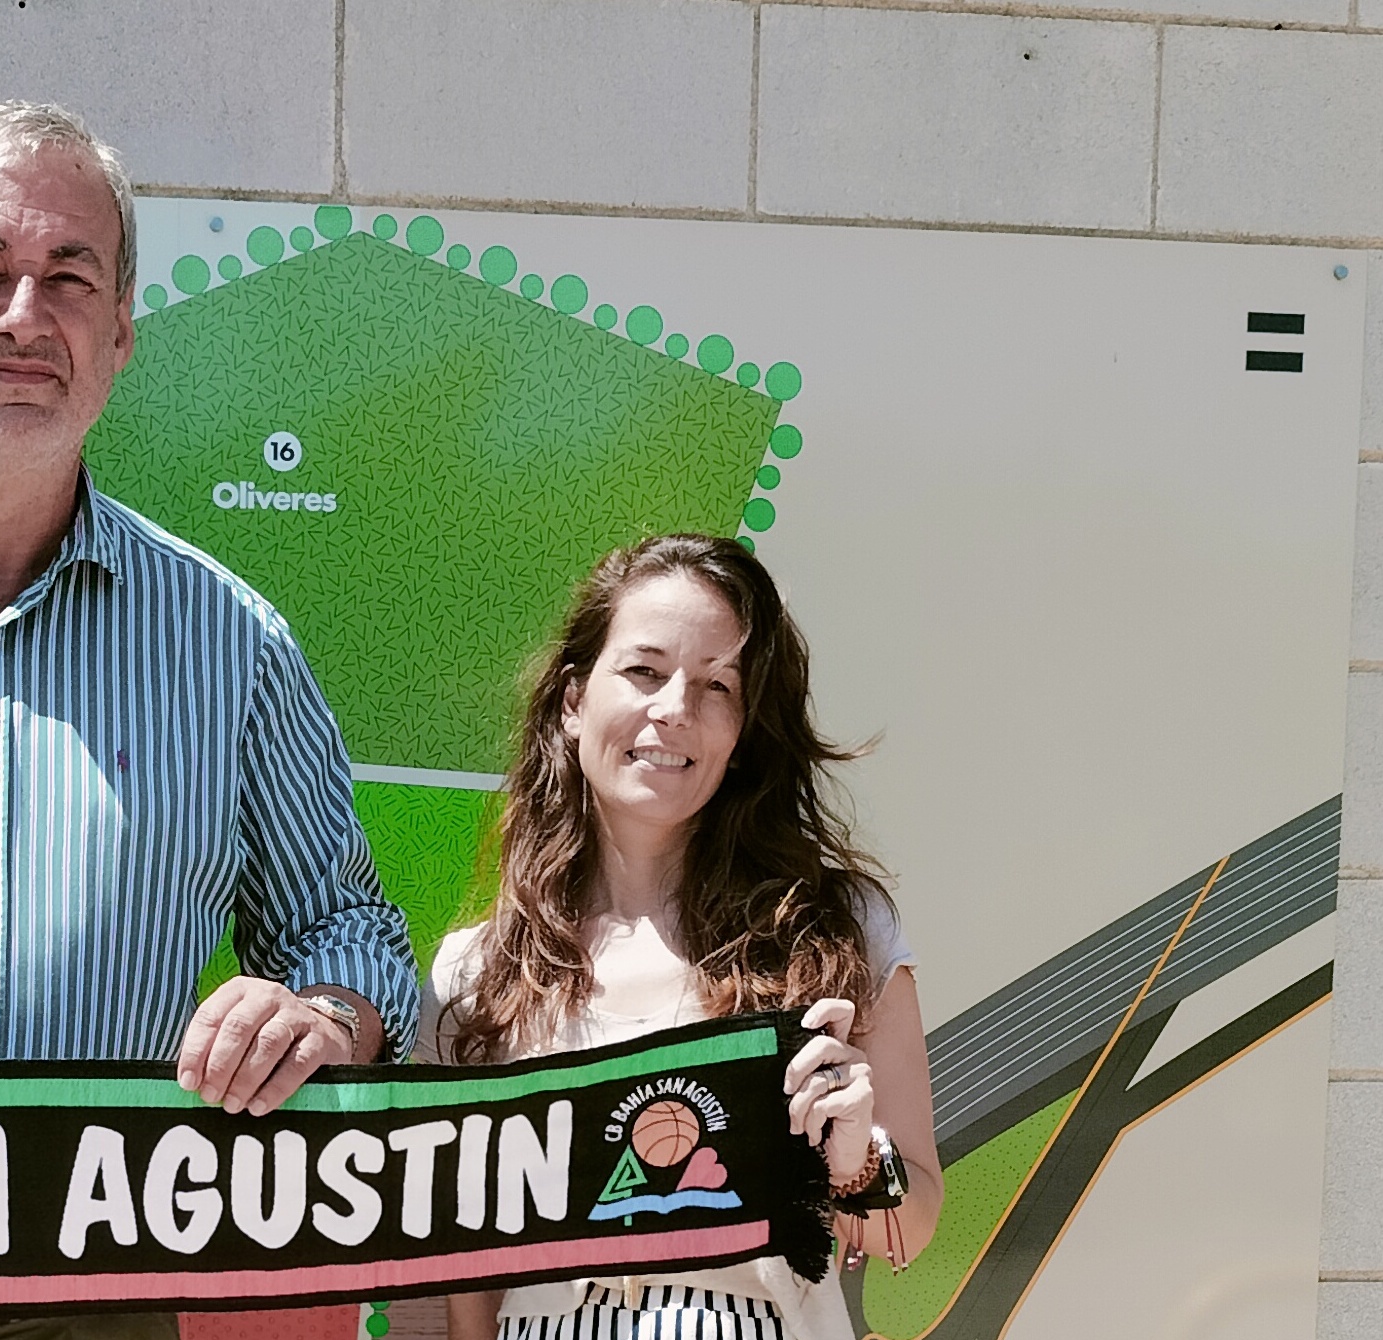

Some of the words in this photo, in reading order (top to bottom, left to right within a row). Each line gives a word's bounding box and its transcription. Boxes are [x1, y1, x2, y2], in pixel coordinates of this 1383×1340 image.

[270, 441, 295, 462] 16
[212, 480, 337, 513] Oliveres
[604, 1124, 623, 1142] CB
[656, 1076, 686, 1094] SAN
[58, 1100, 573, 1260] AGUSTIN
